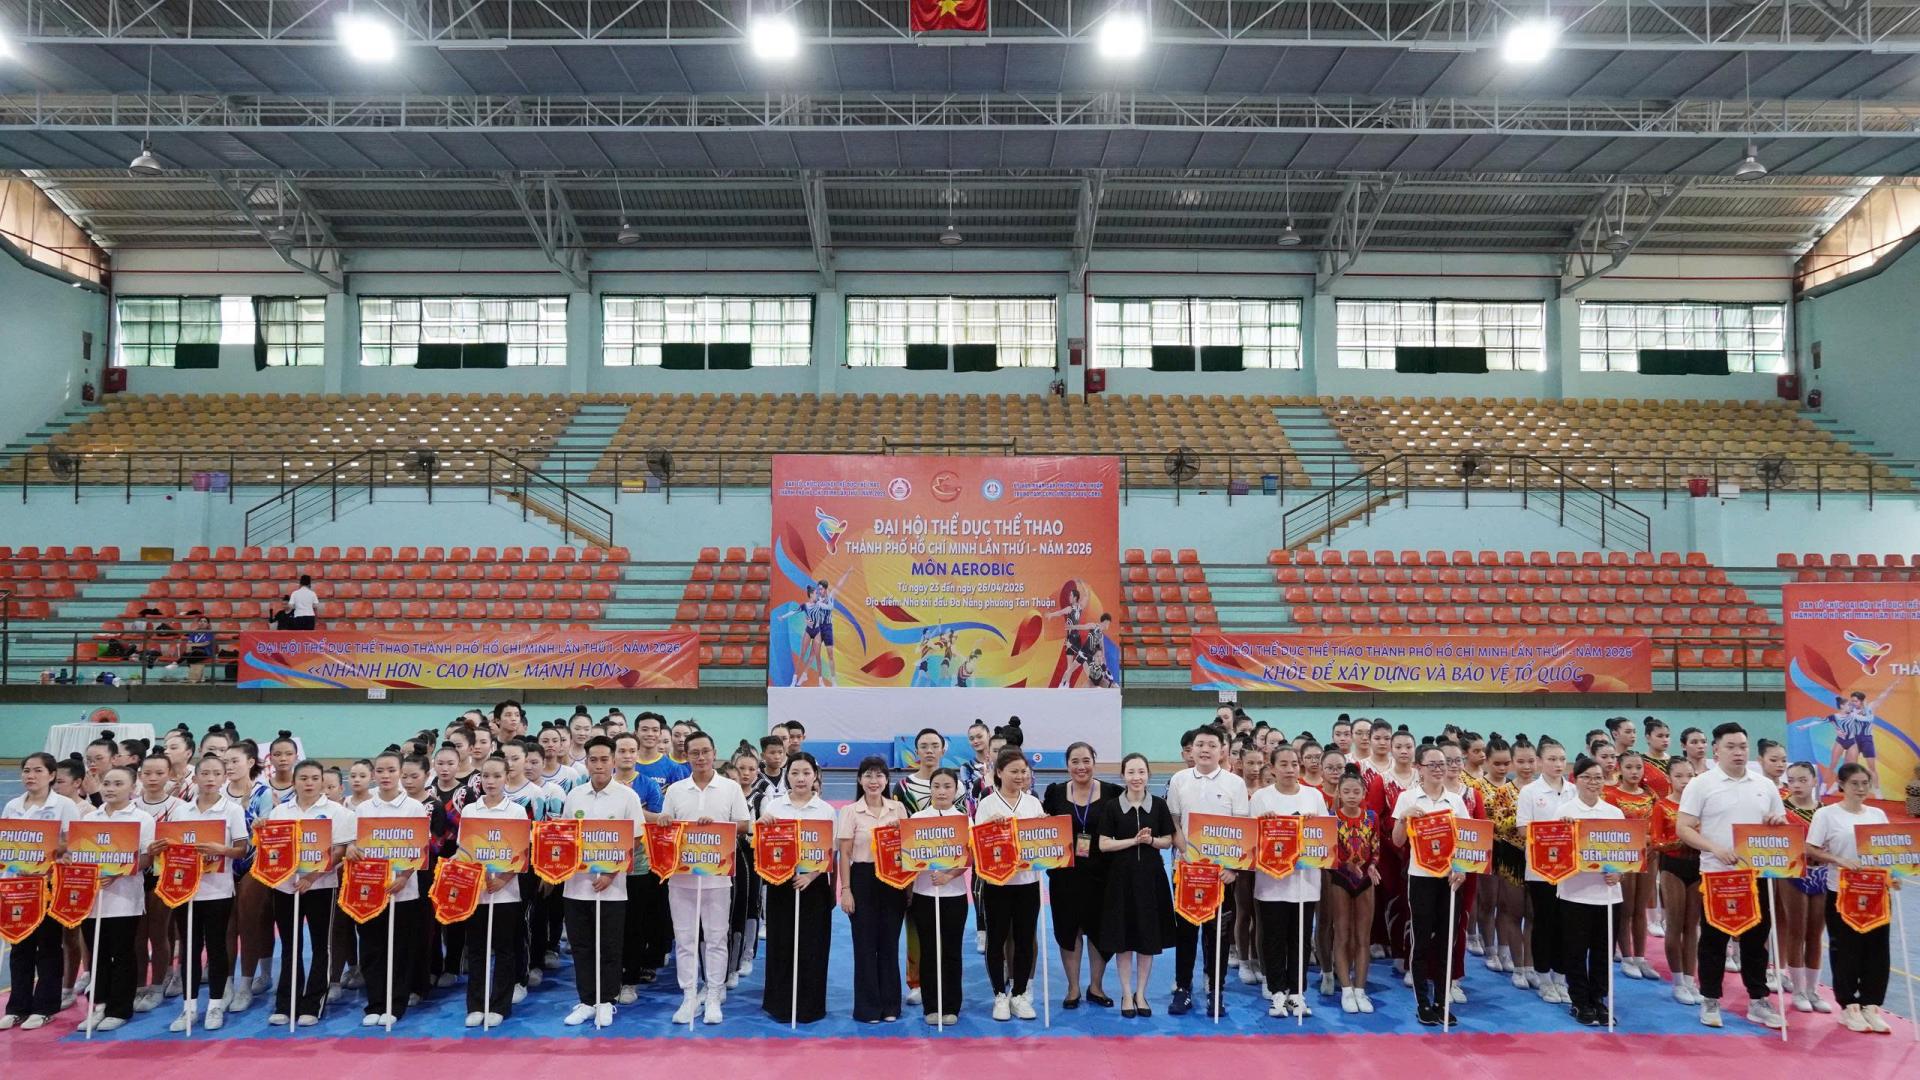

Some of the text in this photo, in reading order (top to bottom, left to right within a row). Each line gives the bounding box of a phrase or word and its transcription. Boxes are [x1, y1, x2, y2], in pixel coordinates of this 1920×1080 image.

[874, 511, 1064, 539] ĐẠI HỘI THỂ DỤC THỂ THAO
[845, 538, 882, 554] THÀNH
[884, 537, 907, 554] PHỐ
[910, 536, 926, 554] HỒ
[928, 539, 946, 554] CHÍ
[948, 542, 977, 554] MINH
[979, 537, 1000, 555] LẦN
[1002, 539, 1025, 555] THỨ
[1039, 540, 1064, 555] NĂM
[1066, 542, 1092, 555] 2026
[911, 558, 1015, 576] MÔN AEROBIC
[977, 583, 1025, 593] 26/04/2026
[1031, 597, 1056, 609] Thuận
[257, 641, 277, 658] ĐẠI
[280, 638, 300, 658] HỘI
[303, 637, 326, 654] THỂ
[328, 642, 352, 657] DỤC
[354, 638, 377, 654] THỂ
[378, 642, 409, 654] THAO
[413, 640, 452, 654] THÀNH
[455, 639, 481, 654] PHỐ
[482, 639, 500, 654] HỒ
[502, 639, 521, 654] CHÍ
[524, 643, 555, 654] MINH
[558, 639, 580, 655] LẦN
[584, 639, 607, 654] THỨ
[623, 640, 650, 654] NĂM
[652, 643, 680, 654] 2026
[1209, 644, 1229, 660] ĐẠI
[1232, 641, 1253, 659] HỘI
[1256, 640, 1279, 656] THỂ
[1281, 645, 1304, 660] DỤC
[1307, 640, 1330, 657] THỂ
[1332, 645, 1363, 657] THAO
[1367, 643, 1406, 657] THÀNH
[1409, 640, 1433, 657] PHỐ
[1435, 641, 1453, 657] HỒ
[1456, 642, 1475, 657] CHÍ
[1478, 646, 1508, 657] MINH
[1511, 641, 1534, 657] LẦN
[1536, 642, 1560, 657] THỨ
[1576, 643, 1601, 657] NĂM
[1605, 646, 1633, 657] 2026
[384, 662, 422, 678] HƠN
[436, 662, 469, 678] CAO
[472, 662, 510, 678] HƠN
[523, 662, 575, 681] MẠNH
[1263, 658, 1585, 685] KHỎE ĐỂ XÂY DỰNG VÀ BẢO VỆ TỔ QUỐC
[1889, 660, 1920, 676] THÀ
[840, 745, 847, 753] 2
[0, 829, 44, 843] PHƯỜNG
[98, 831, 111, 844] XÃ
[183, 830, 196, 844] XÃ
[373, 827, 414, 840] PHƯỜNG
[488, 828, 501, 841] XÃ
[684, 831, 721, 845] HƯỜNG
[915, 826, 955, 840] PHƯỜNG
[1019, 827, 1058, 841] PHƯỜNG
[1203, 825, 1242, 839] PHƯỜNG
[1303, 826, 1322, 839] ỜNG
[1457, 827, 1478, 841] ỜNG
[1590, 830, 1631, 843] PHƯỜNG
[1748, 834, 1790, 848] PHƯỜNG
[1870, 833, 1912, 846] PHƯỜNG
[476, 847, 496, 860] NHÀ
[808, 847, 825, 863] HỘI
[1020, 847, 1034, 860] HỢ
[1861, 854, 1874, 865] AN
